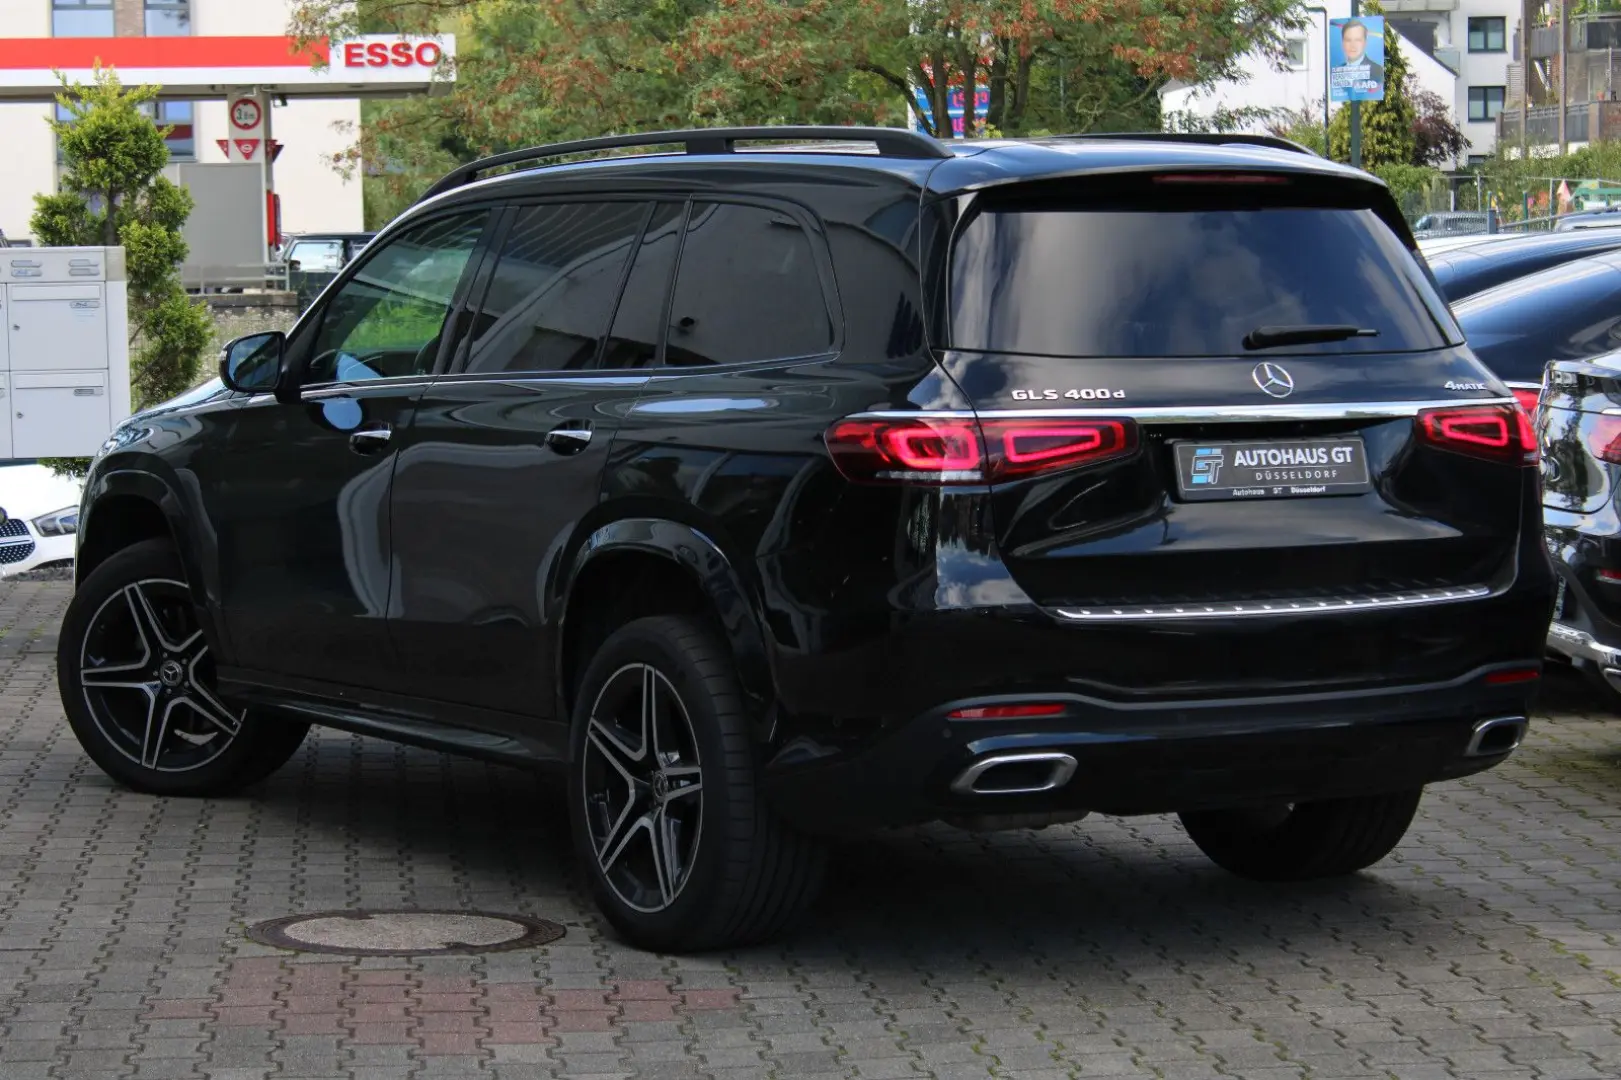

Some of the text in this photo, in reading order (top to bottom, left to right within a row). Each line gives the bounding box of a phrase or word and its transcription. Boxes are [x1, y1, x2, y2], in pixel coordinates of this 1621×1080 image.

[344, 42, 441, 68] ESSO
[1011, 389, 1059, 400] GLS
[1233, 446, 1353, 467] AUTOHAUS GT
[1256, 470, 1338, 481] DÜSSELDORF
[1232, 488, 1265, 496] Autohaus
[1291, 485, 1326, 494] Düsseldorf
